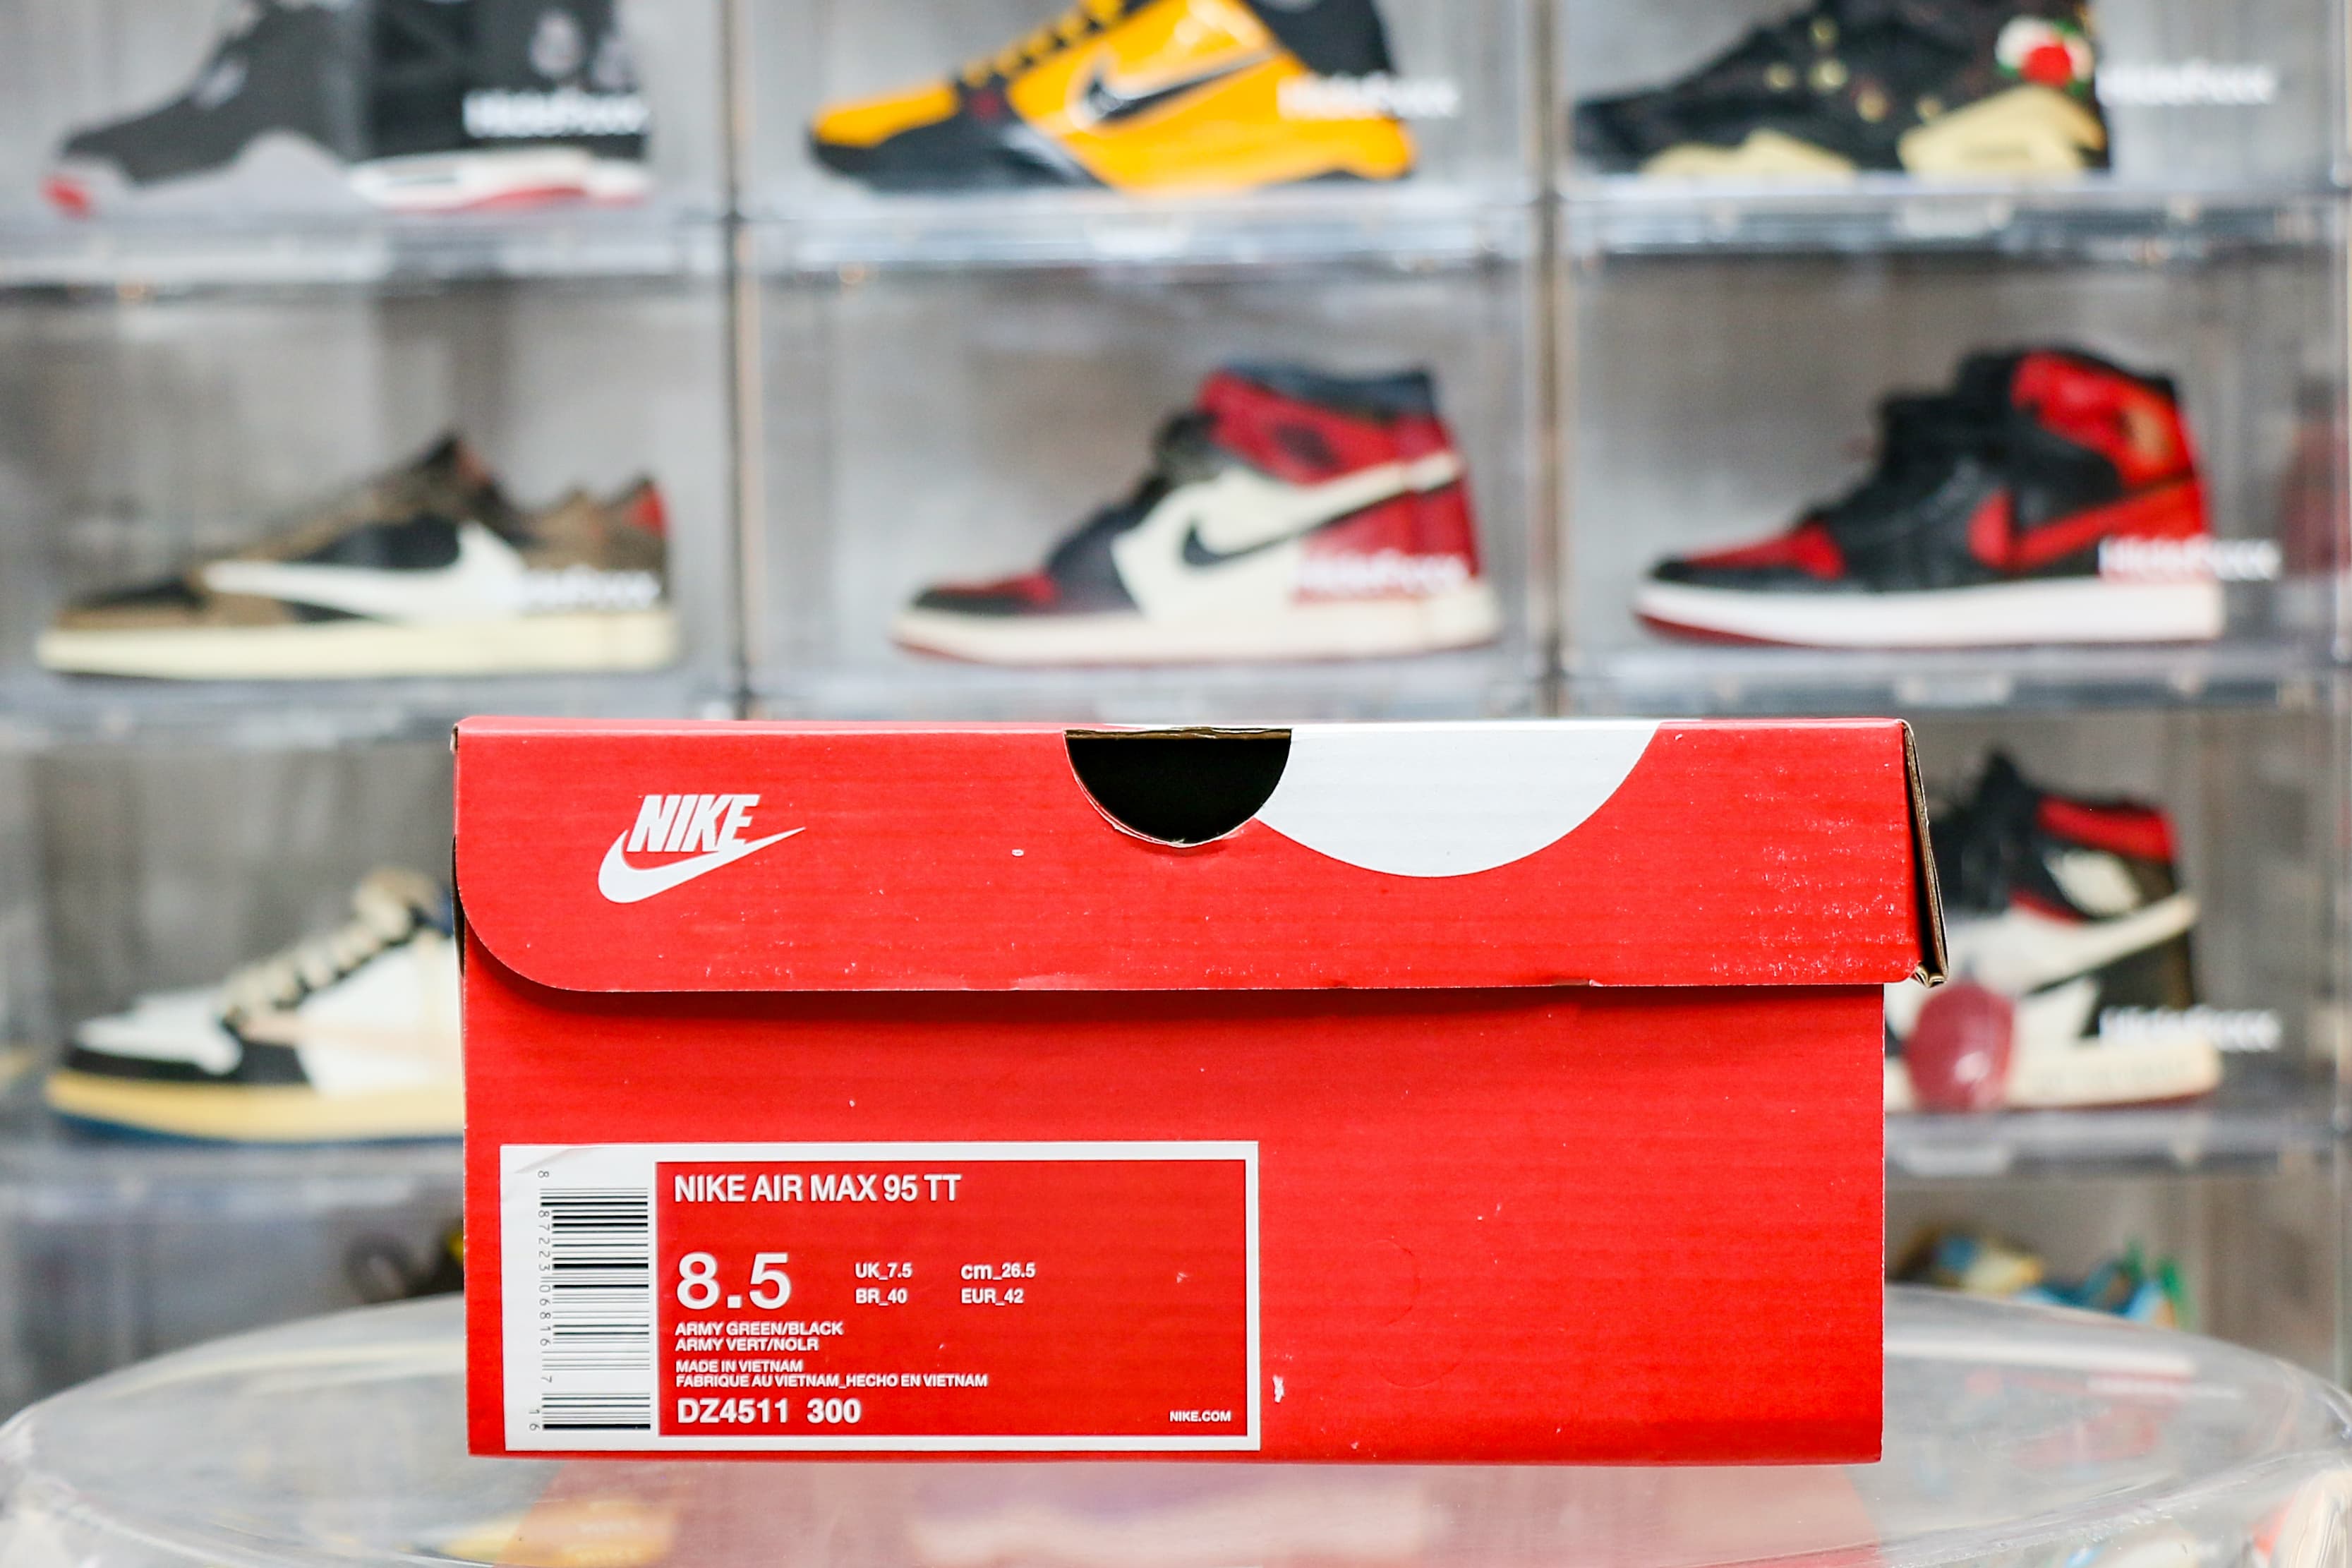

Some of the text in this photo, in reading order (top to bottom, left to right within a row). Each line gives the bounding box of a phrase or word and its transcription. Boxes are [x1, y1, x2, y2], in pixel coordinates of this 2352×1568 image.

[627, 794, 761, 852] NIKE
[675, 1174, 962, 1202] NIKE AIR MAX 95 TT
[856, 1262, 1035, 1279] UK_7.5 cm_26.5
[677, 1253, 791, 1309] 8.5
[856, 1288, 1023, 1305] BR_40 EUR_42
[675, 1321, 843, 1336] ARMY GREEN/BLACK
[675, 1338, 819, 1351] ARMY VERT/NOLR
[676, 1360, 803, 1373] MADE IN VIETNAM
[676, 1374, 988, 1389] FABRIQUE AU VIETNAM_HECHO EN VIETNAM
[678, 1399, 861, 1423] DZ4511 300
[1170, 1410, 1231, 1422] NIKE.COM
